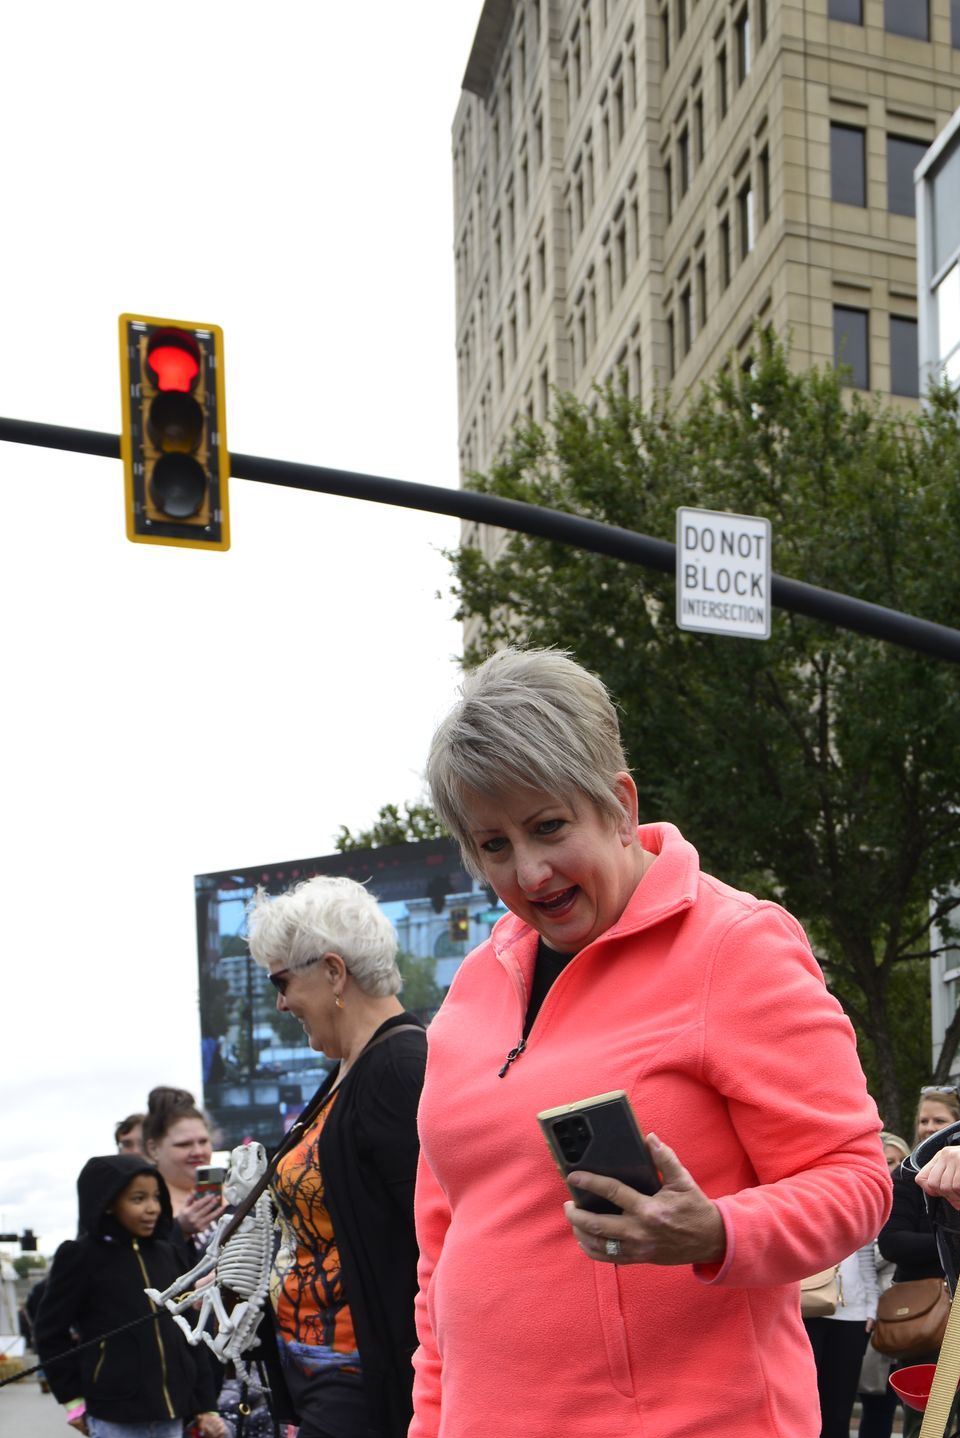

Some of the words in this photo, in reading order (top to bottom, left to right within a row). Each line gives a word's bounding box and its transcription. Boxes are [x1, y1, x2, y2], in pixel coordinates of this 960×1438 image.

[685, 525, 715, 553] DO
[720, 530, 765, 560] NOT
[685, 564, 763, 598] BLOCK
[683, 598, 764, 624] INTERSECTION
